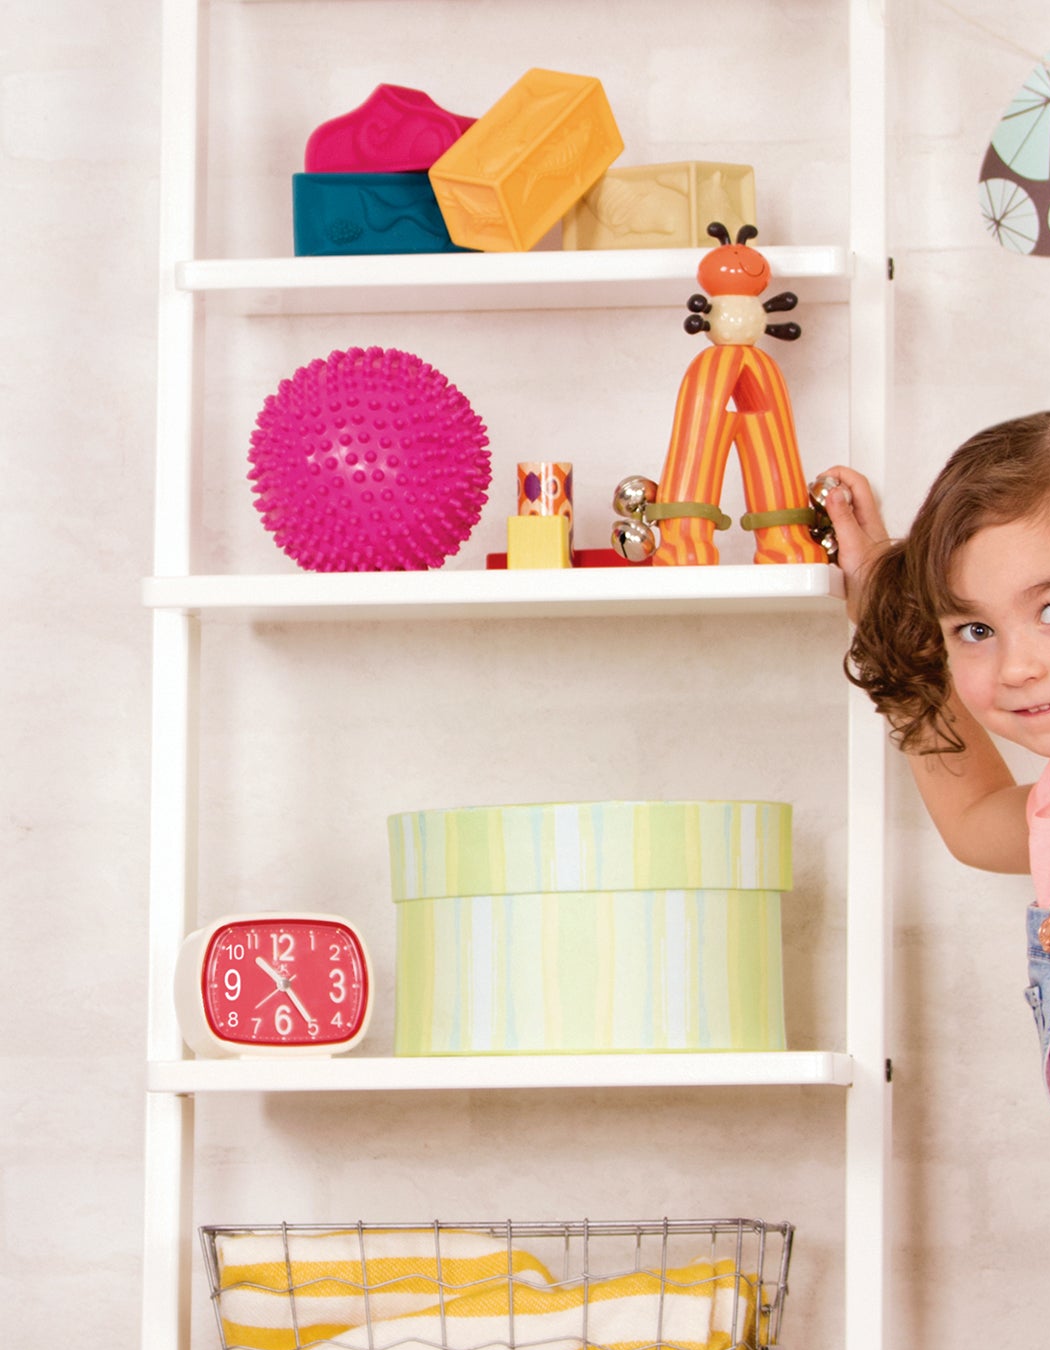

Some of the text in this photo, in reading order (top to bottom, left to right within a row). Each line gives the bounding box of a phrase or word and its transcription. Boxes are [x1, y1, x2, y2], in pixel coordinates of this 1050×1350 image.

[246, 934, 259, 949] 11
[270, 934, 294, 961] 12
[309, 934, 315, 950] 1
[226, 944, 244, 960] 10
[329, 944, 340, 961] 2
[224, 969, 241, 1001] 9
[329, 969, 346, 1003] 3
[228, 1011, 238, 1027] 8
[251, 1018, 262, 1035] 7
[275, 1005, 292, 1035] 6
[307, 1019, 319, 1036] 5
[330, 1012, 343, 1028] 4
